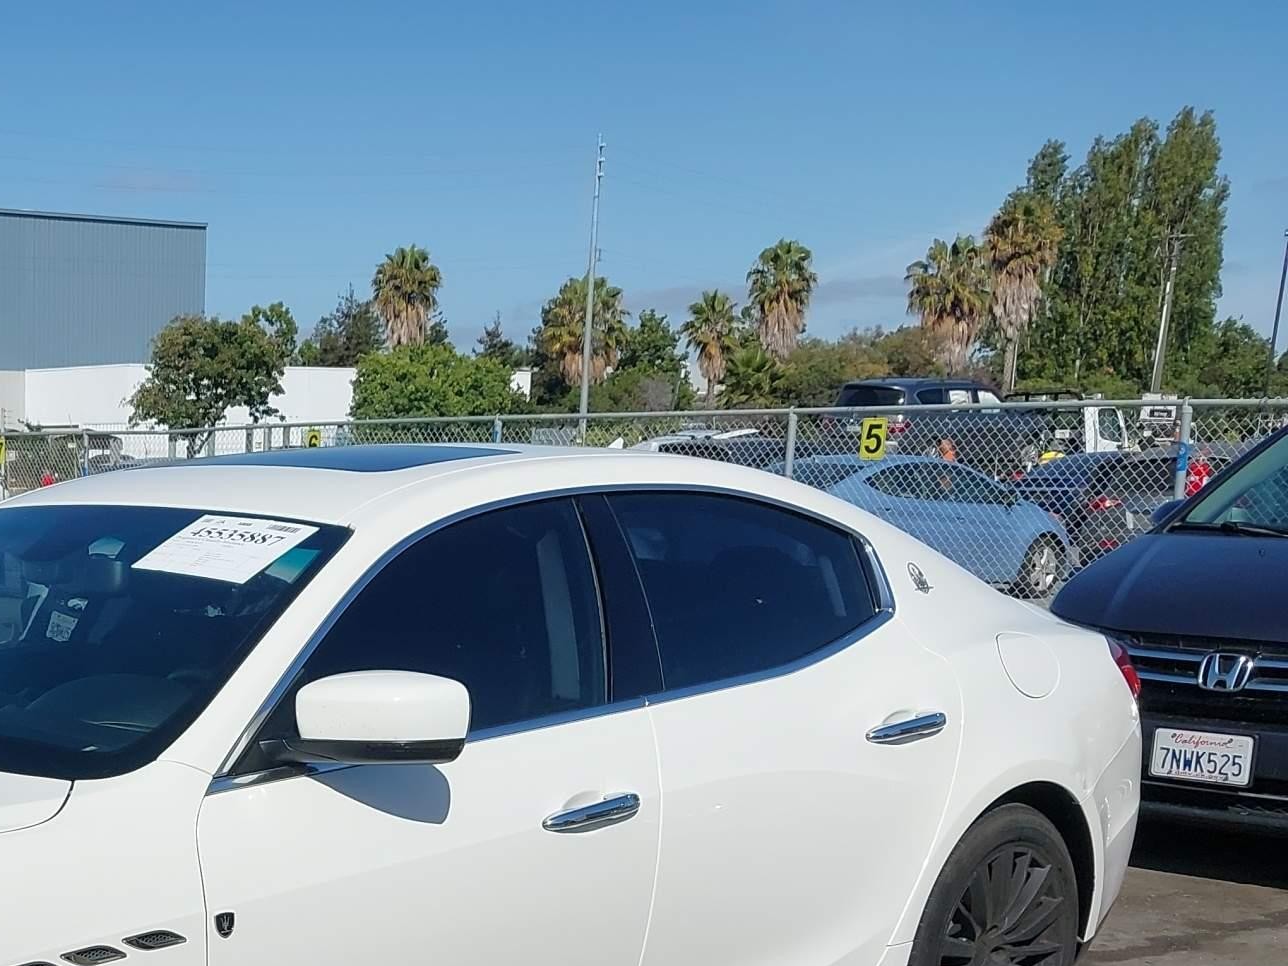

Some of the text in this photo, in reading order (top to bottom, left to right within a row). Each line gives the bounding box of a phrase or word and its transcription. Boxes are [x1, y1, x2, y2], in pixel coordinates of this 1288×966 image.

[863, 423, 883, 454] 5
[190, 527, 287, 547] 45535887
[1174, 733, 1233, 748] California
[1159, 746, 1242, 777] 7NWK525
